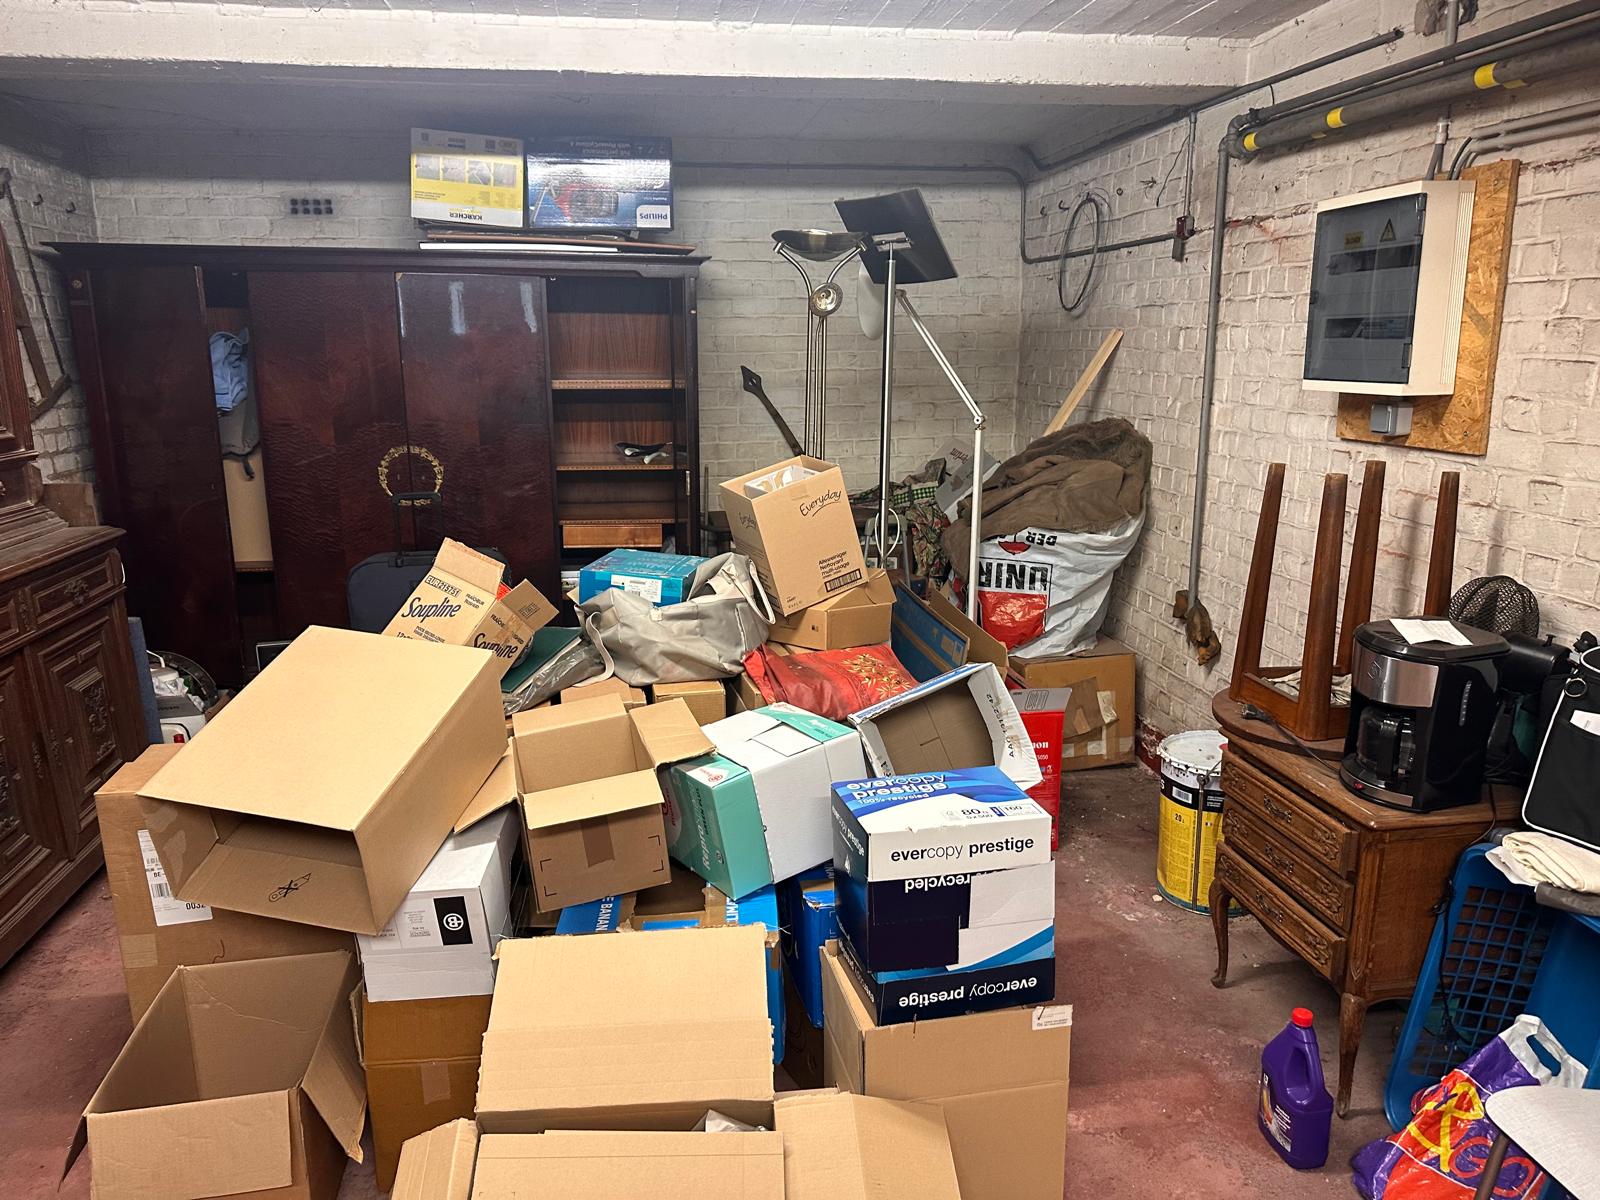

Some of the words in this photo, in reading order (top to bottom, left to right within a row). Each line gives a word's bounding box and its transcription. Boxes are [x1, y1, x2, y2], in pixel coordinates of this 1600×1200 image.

[639, 212, 668, 220] PHILIPS
[799, 490, 841, 517] Everyday
[425, 575, 440, 587] EUR
[401, 596, 462, 623] Soupline
[846, 772, 946, 790] evercopy
[852, 781, 949, 800] prestige
[961, 808, 981, 816] 80
[891, 843, 963, 862] evercopy
[968, 836, 1035, 858] prestige
[904, 874, 971, 894] recycled
[898, 985, 965, 1007] prestige
[969, 976, 1038, 997] evercopy
